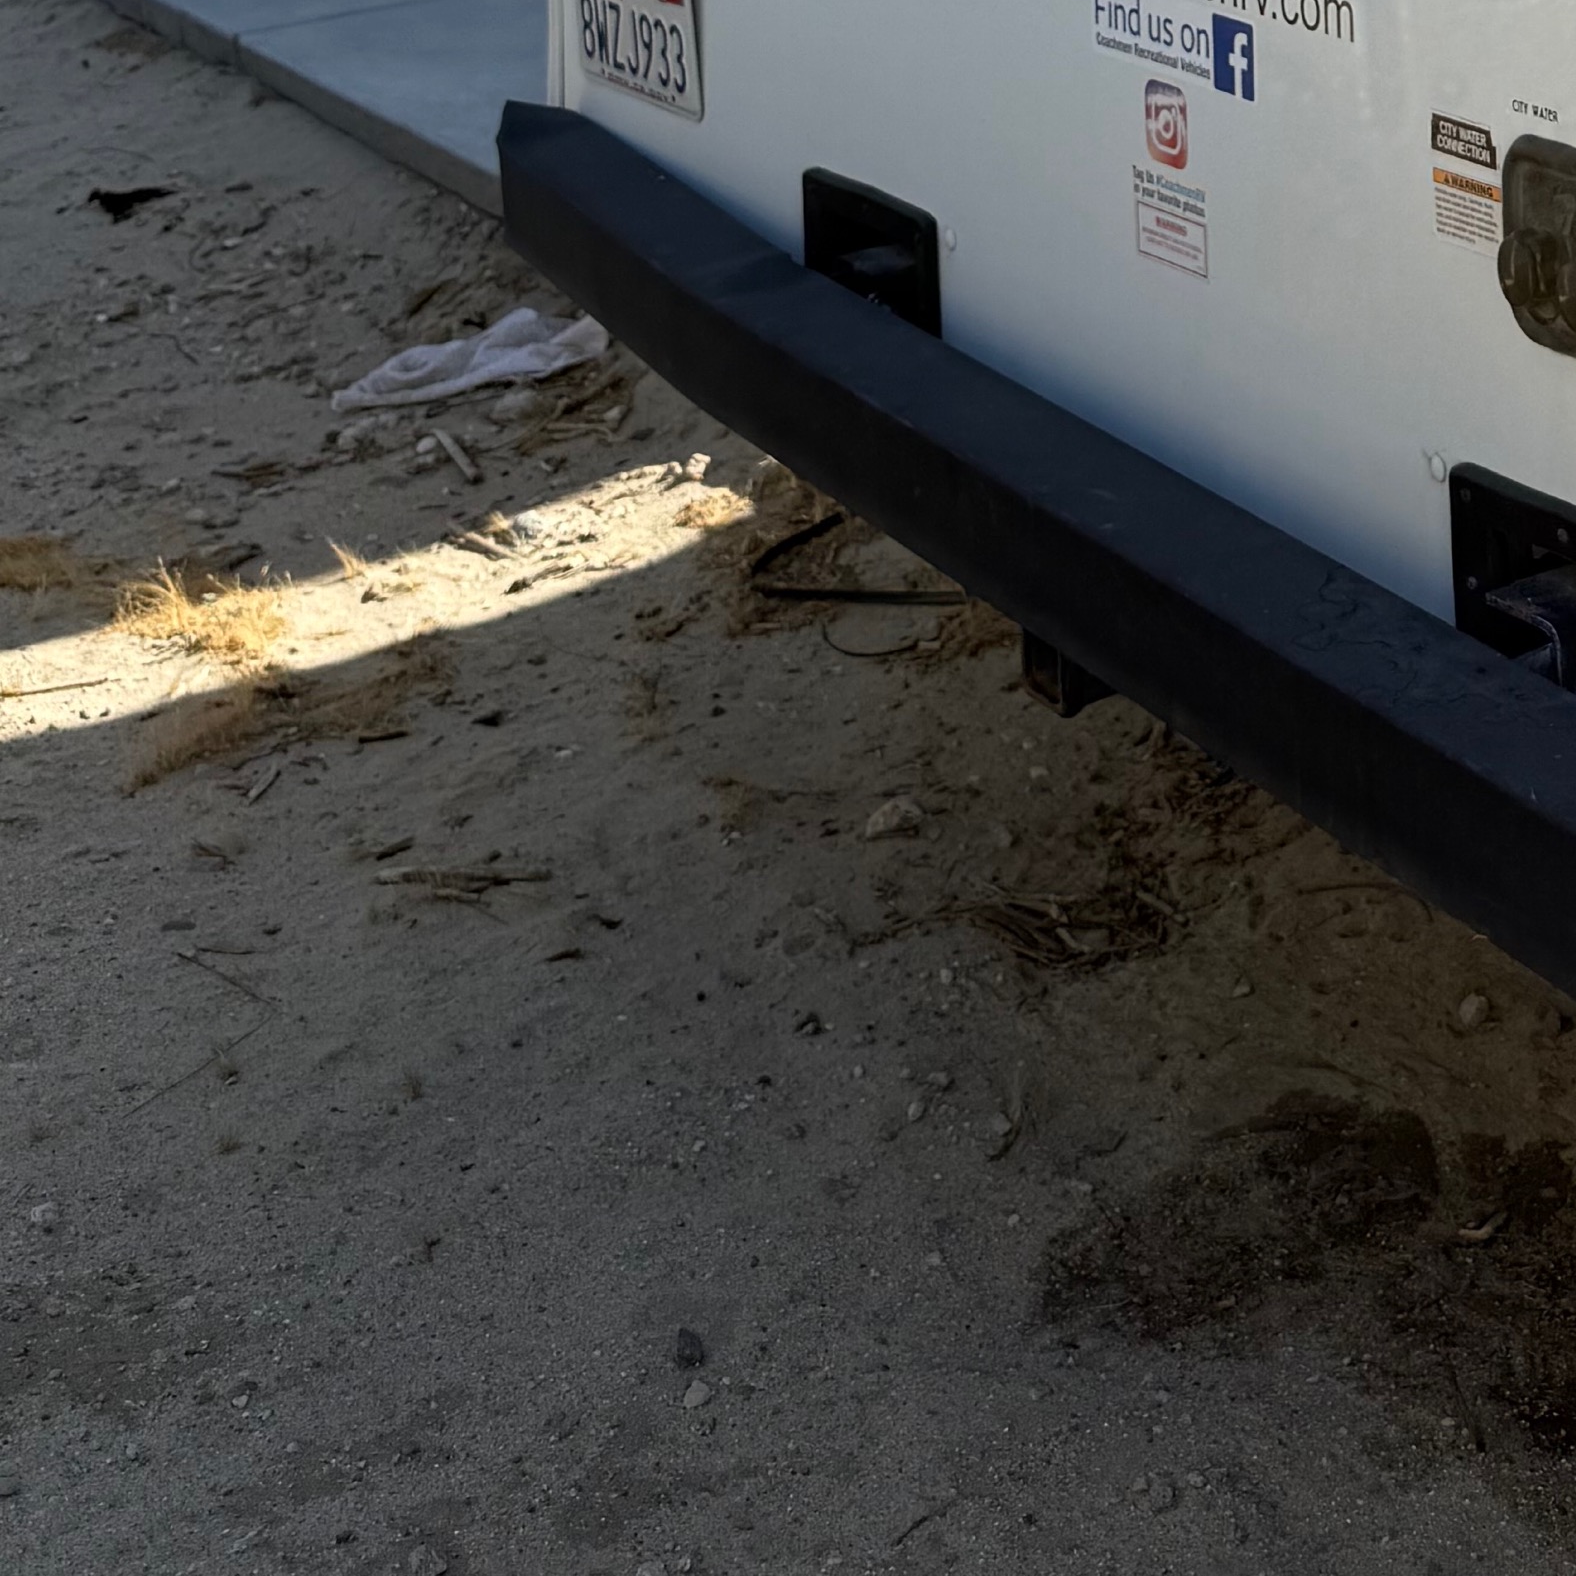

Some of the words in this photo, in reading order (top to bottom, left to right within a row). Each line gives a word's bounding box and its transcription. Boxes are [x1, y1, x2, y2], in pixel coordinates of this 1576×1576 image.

[1148, 13, 1174, 47] us
[1181, 23, 1210, 59] on
[1512, 99, 1528, 115] CITY
[1532, 104, 1558, 123] WATER
[1439, 120, 1457, 137] CITY
[1458, 126, 1487, 148] WATER
[1436, 134, 1491, 164] CONNECTION
[1450, 174, 1493, 198] WARNING
